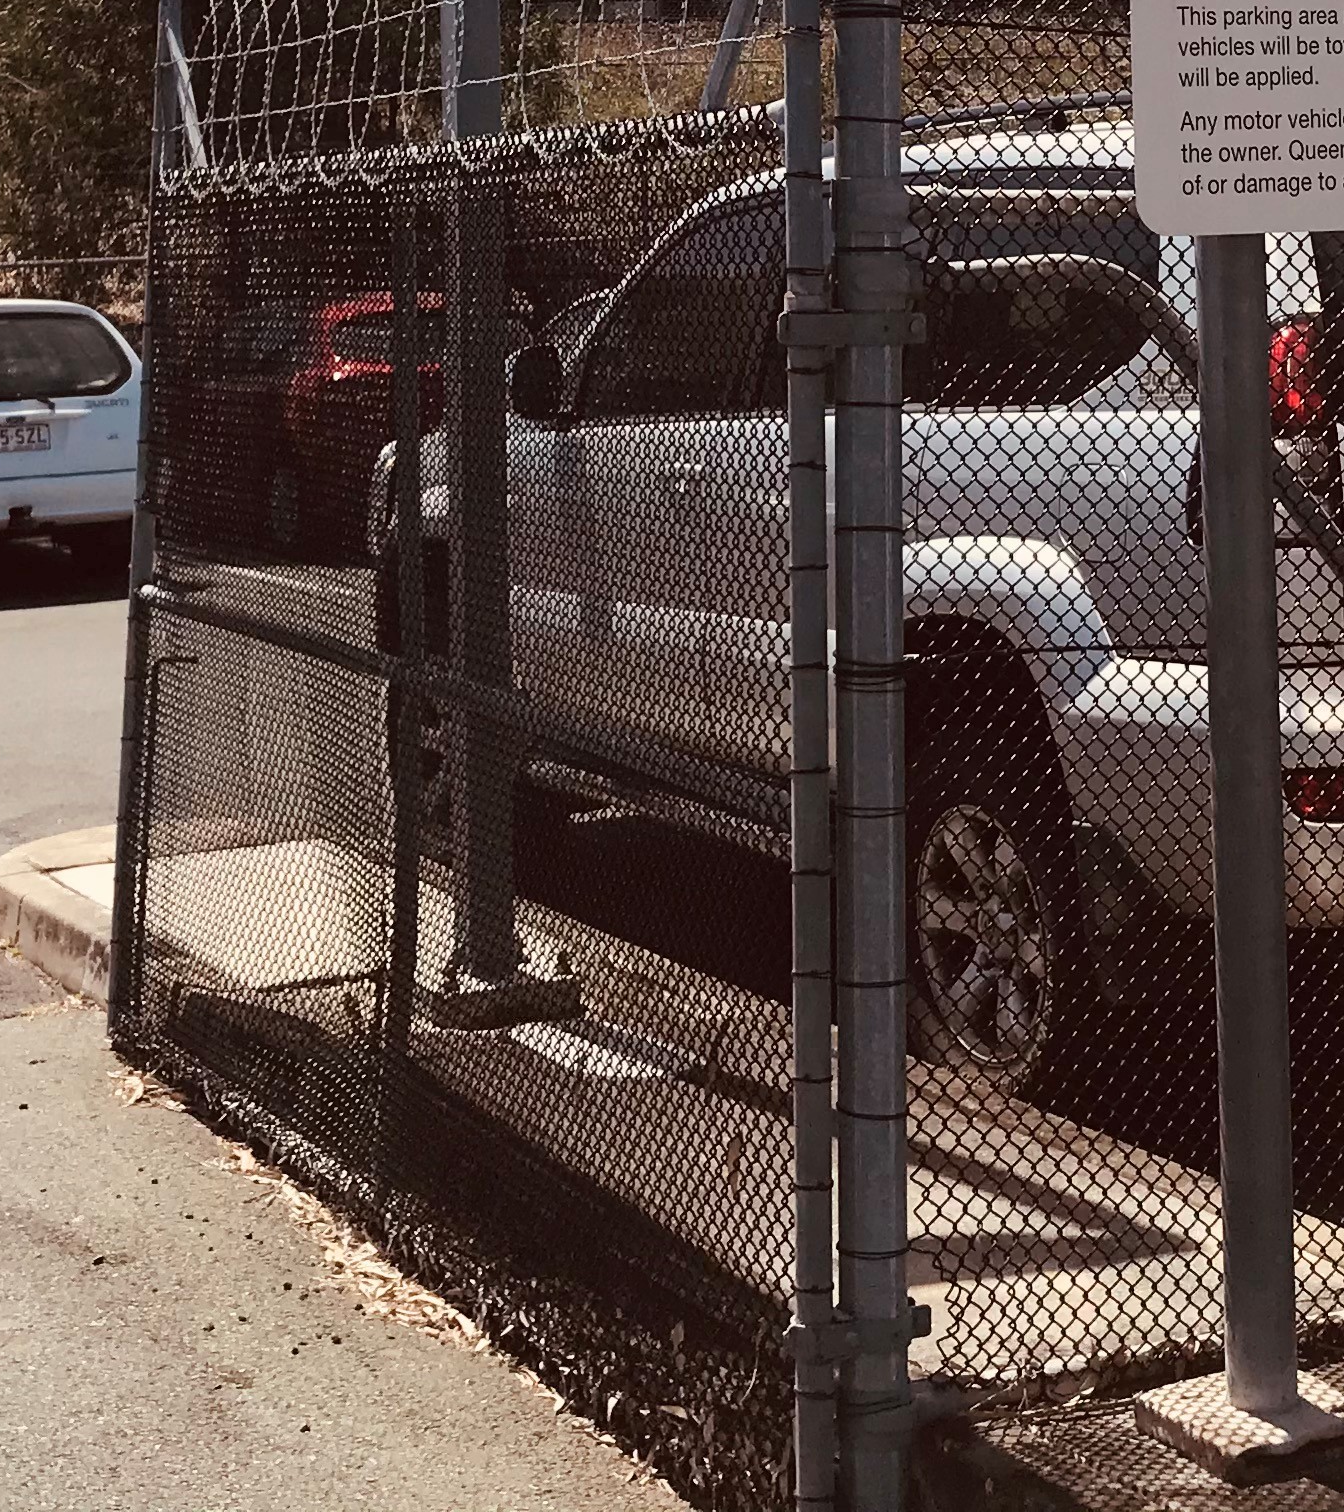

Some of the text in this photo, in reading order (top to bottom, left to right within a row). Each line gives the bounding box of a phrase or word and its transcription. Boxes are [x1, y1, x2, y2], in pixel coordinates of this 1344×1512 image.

[1176, 6, 1217, 26] This
[1223, 5, 1292, 30] parking
[1298, 9, 1339, 25] area
[1178, 36, 1255, 57] vehicles
[1259, 35, 1290, 56] will
[1296, 35, 1320, 55] be
[1178, 65, 1319, 91] will be applied.
[1180, 110, 1218, 137] Any
[1224, 110, 1283, 131] motor
[1180, 142, 1213, 164] the
[1218, 145, 1282, 163] owner.
[1182, 174, 1204, 196] of
[1207, 178, 1228, 195] or
[1233, 172, 1312, 197] damage
[1317, 171, 1337, 191] to
